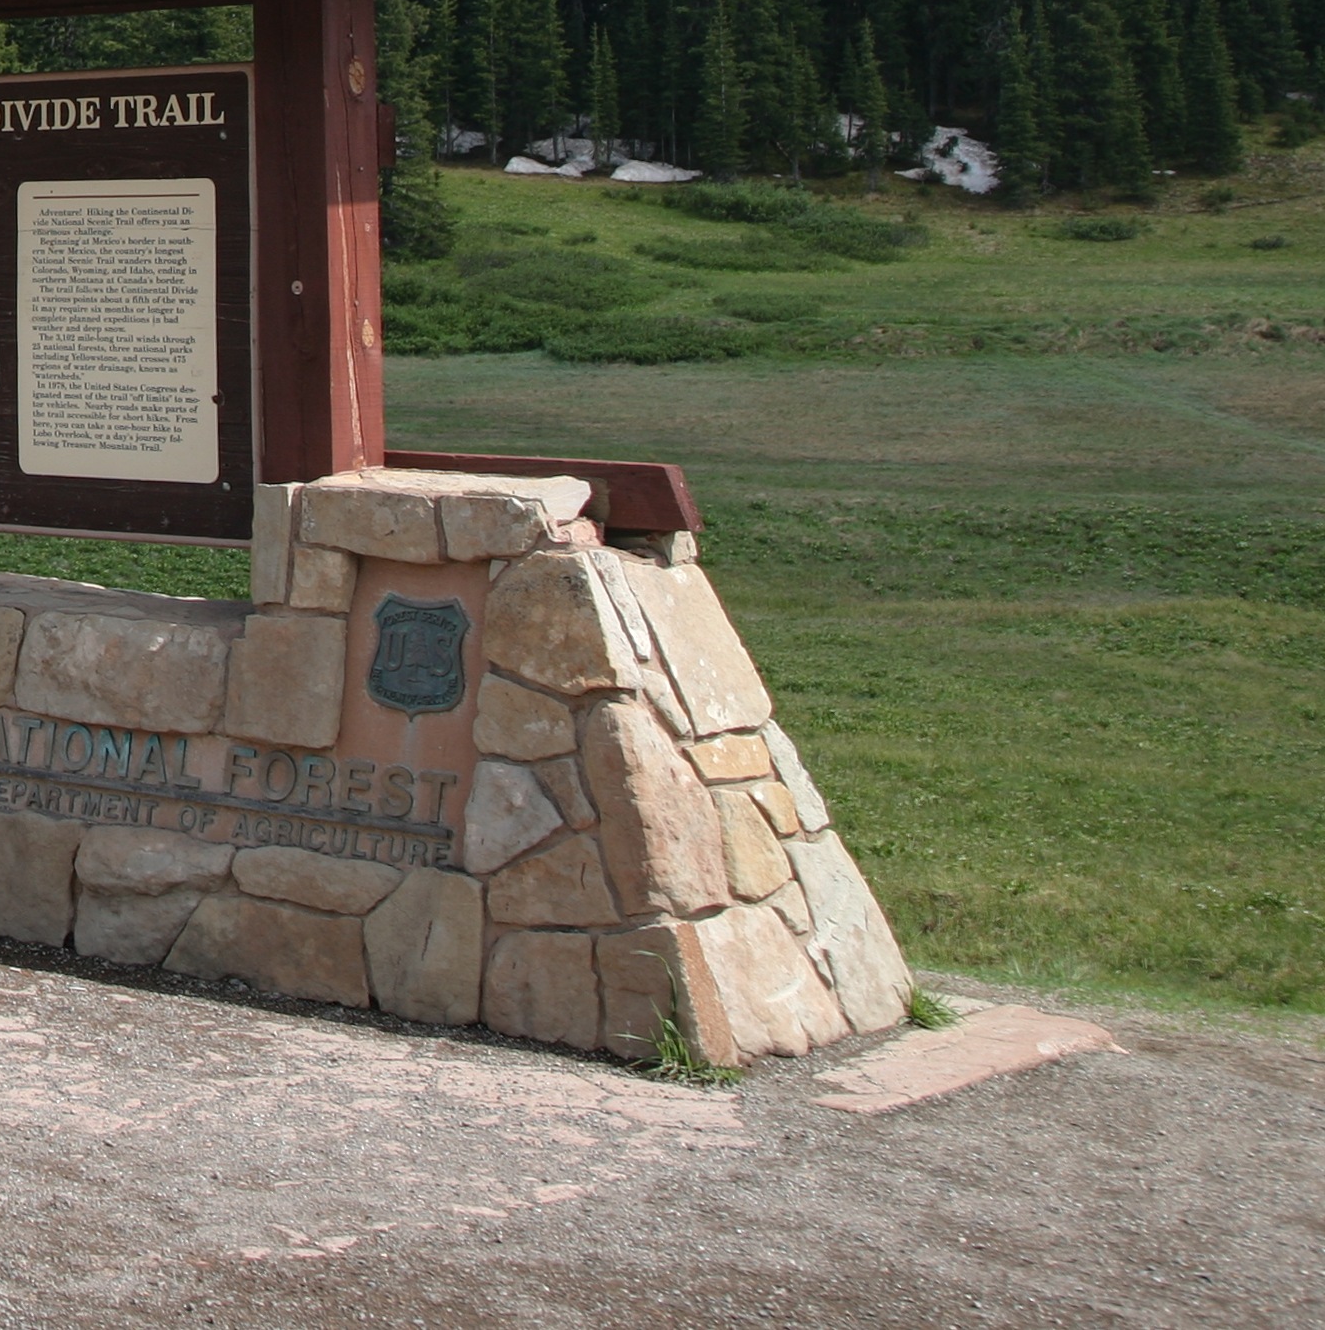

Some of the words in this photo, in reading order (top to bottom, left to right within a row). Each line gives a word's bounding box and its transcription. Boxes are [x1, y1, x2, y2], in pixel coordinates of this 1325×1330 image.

[110, 92, 225, 128] TRAIL
[39, 208, 82, 216] Adventure!
[86, 207, 114, 217] Hiking
[130, 206, 179, 215] Continental
[181, 206, 195, 214] Di-
[51, 218, 84, 226] National
[86, 217, 112, 225] Scenic
[115, 217, 134, 225] Trail
[136, 217, 160, 225] offers
[162, 218, 177, 227] you
[39, 237, 80, 247] Beginning
[168, 236, 193, 244] south-
[67, 246, 97, 255] Mexico,
[114, 246, 152, 256] country's
[154, 246, 184, 256] longest
[154, 256, 187, 266] through
[31, 266, 69, 274] Colorado,
[71, 266, 108, 276] Wyoming,
[129, 266, 155, 275] Idaho,
[157, 266, 186, 276] ending
[116, 276, 153, 284] Canada's
[155, 276, 185, 284] border.
[120, 286, 169, 294] Continental
[171, 286, 198, 294] Divide
[72, 295, 97, 305] points
[99, 295, 122, 303] about
[132, 296, 149, 304] fifth
[161, 296, 175, 304] the
[178, 298, 196, 306] way.
[40, 306, 56, 314] may
[59, 305, 88, 314] require
[104, 304, 134, 313] months
[147, 305, 173, 315] longer
[55, 333, 75, 343] 3,102
[77, 333, 114, 344] mile-long
[115, 334, 133, 342] trail
[136, 334, 160, 343] winds
[162, 335, 195, 346] through
[223, 746, 460, 827] FOREST
[178, 804, 218, 832] OF
[231, 812, 453, 868] AGRICULTURE
